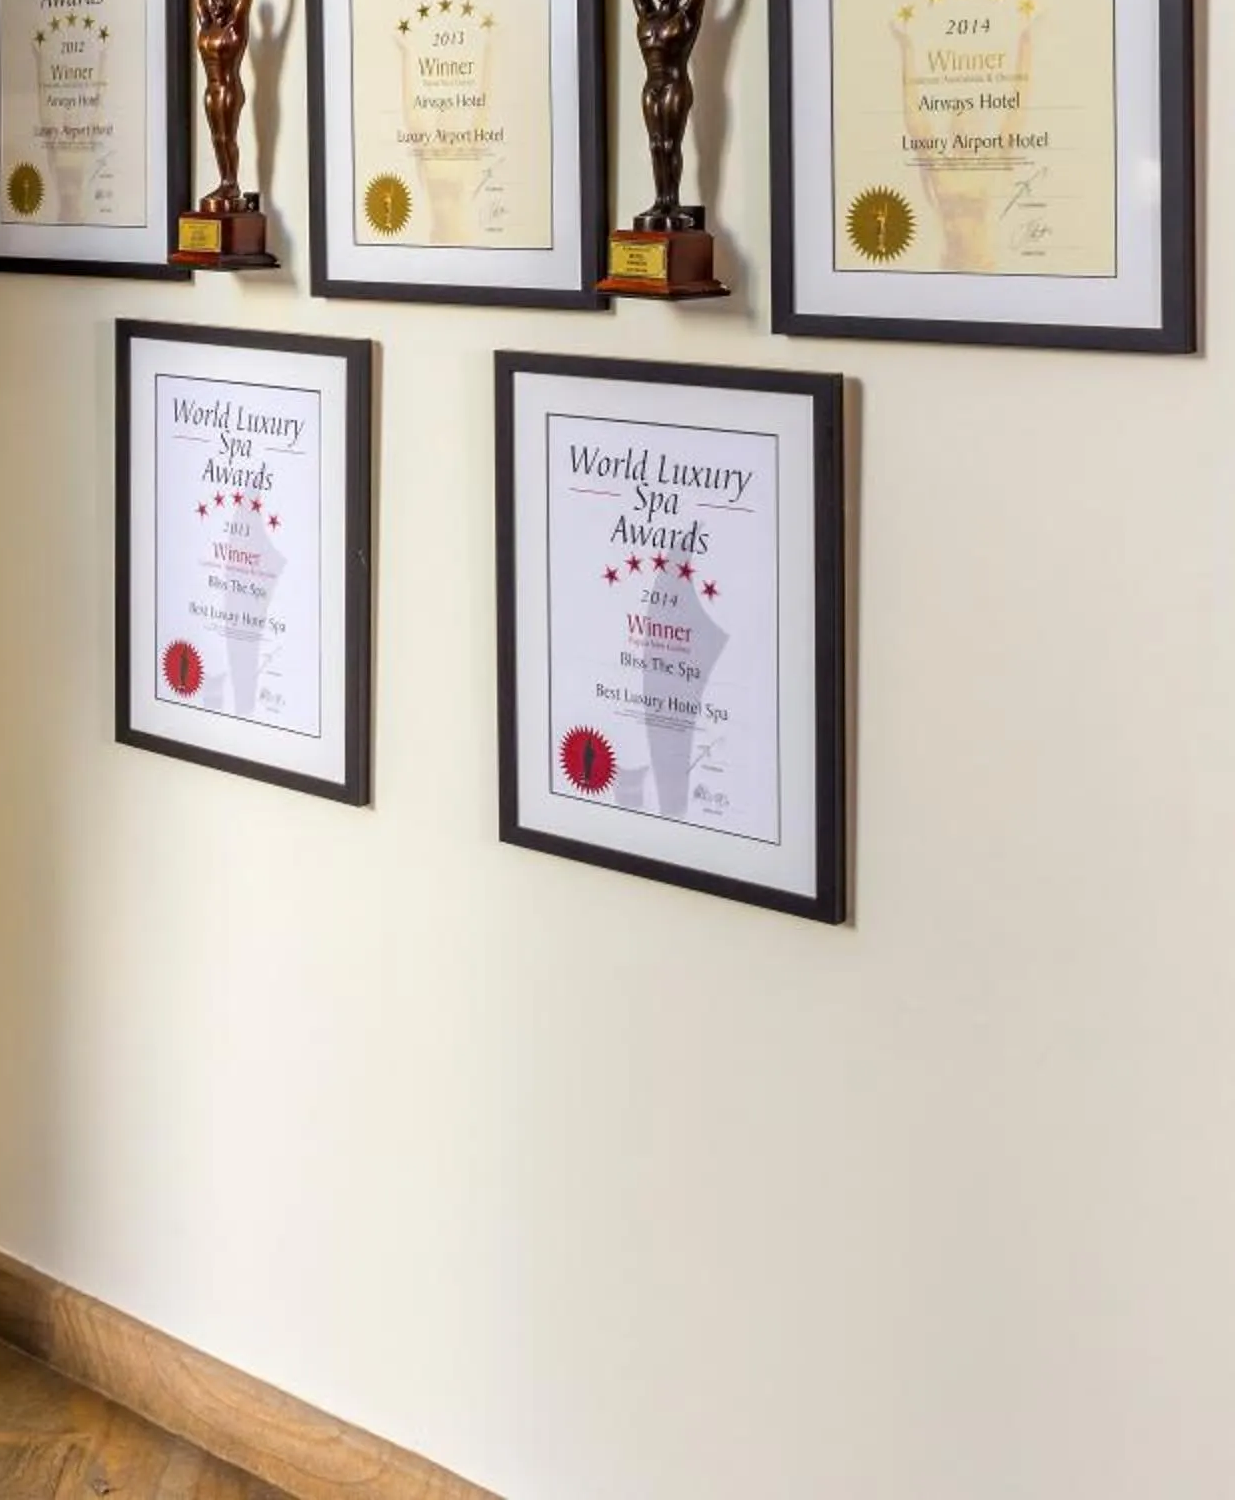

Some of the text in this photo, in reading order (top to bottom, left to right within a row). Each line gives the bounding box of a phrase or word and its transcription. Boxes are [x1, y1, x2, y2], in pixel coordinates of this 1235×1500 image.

[432, 30, 465, 47] 2013
[945, 18, 991, 35] 2014
[60, 41, 85, 55] 2012
[50, 63, 94, 81] Winner
[418, 57, 475, 77] Winner
[927, 50, 1006, 72] Winner
[414, 92, 486, 113] Airways Hotel
[918, 91, 1020, 117] Airways Hotel
[396, 126, 504, 146] Luxury Airport Hotel
[902, 132, 1049, 155] Luxury Airport Hotel
[173, 398, 305, 448] World Luxury
[219, 430, 252, 465] Spa
[202, 458, 274, 491] Awards
[570, 445, 753, 502] World Luxury
[634, 482, 679, 523] Spa
[610, 515, 710, 555] Awards
[640, 589, 678, 607] 2014
[627, 613, 692, 643] Winner
[620, 651, 701, 682] Bliss The Spa
[596, 683, 621, 701] Best
[624, 688, 664, 712] Luxury
[668, 697, 702, 715] Hotel
[706, 703, 728, 724] Spa
